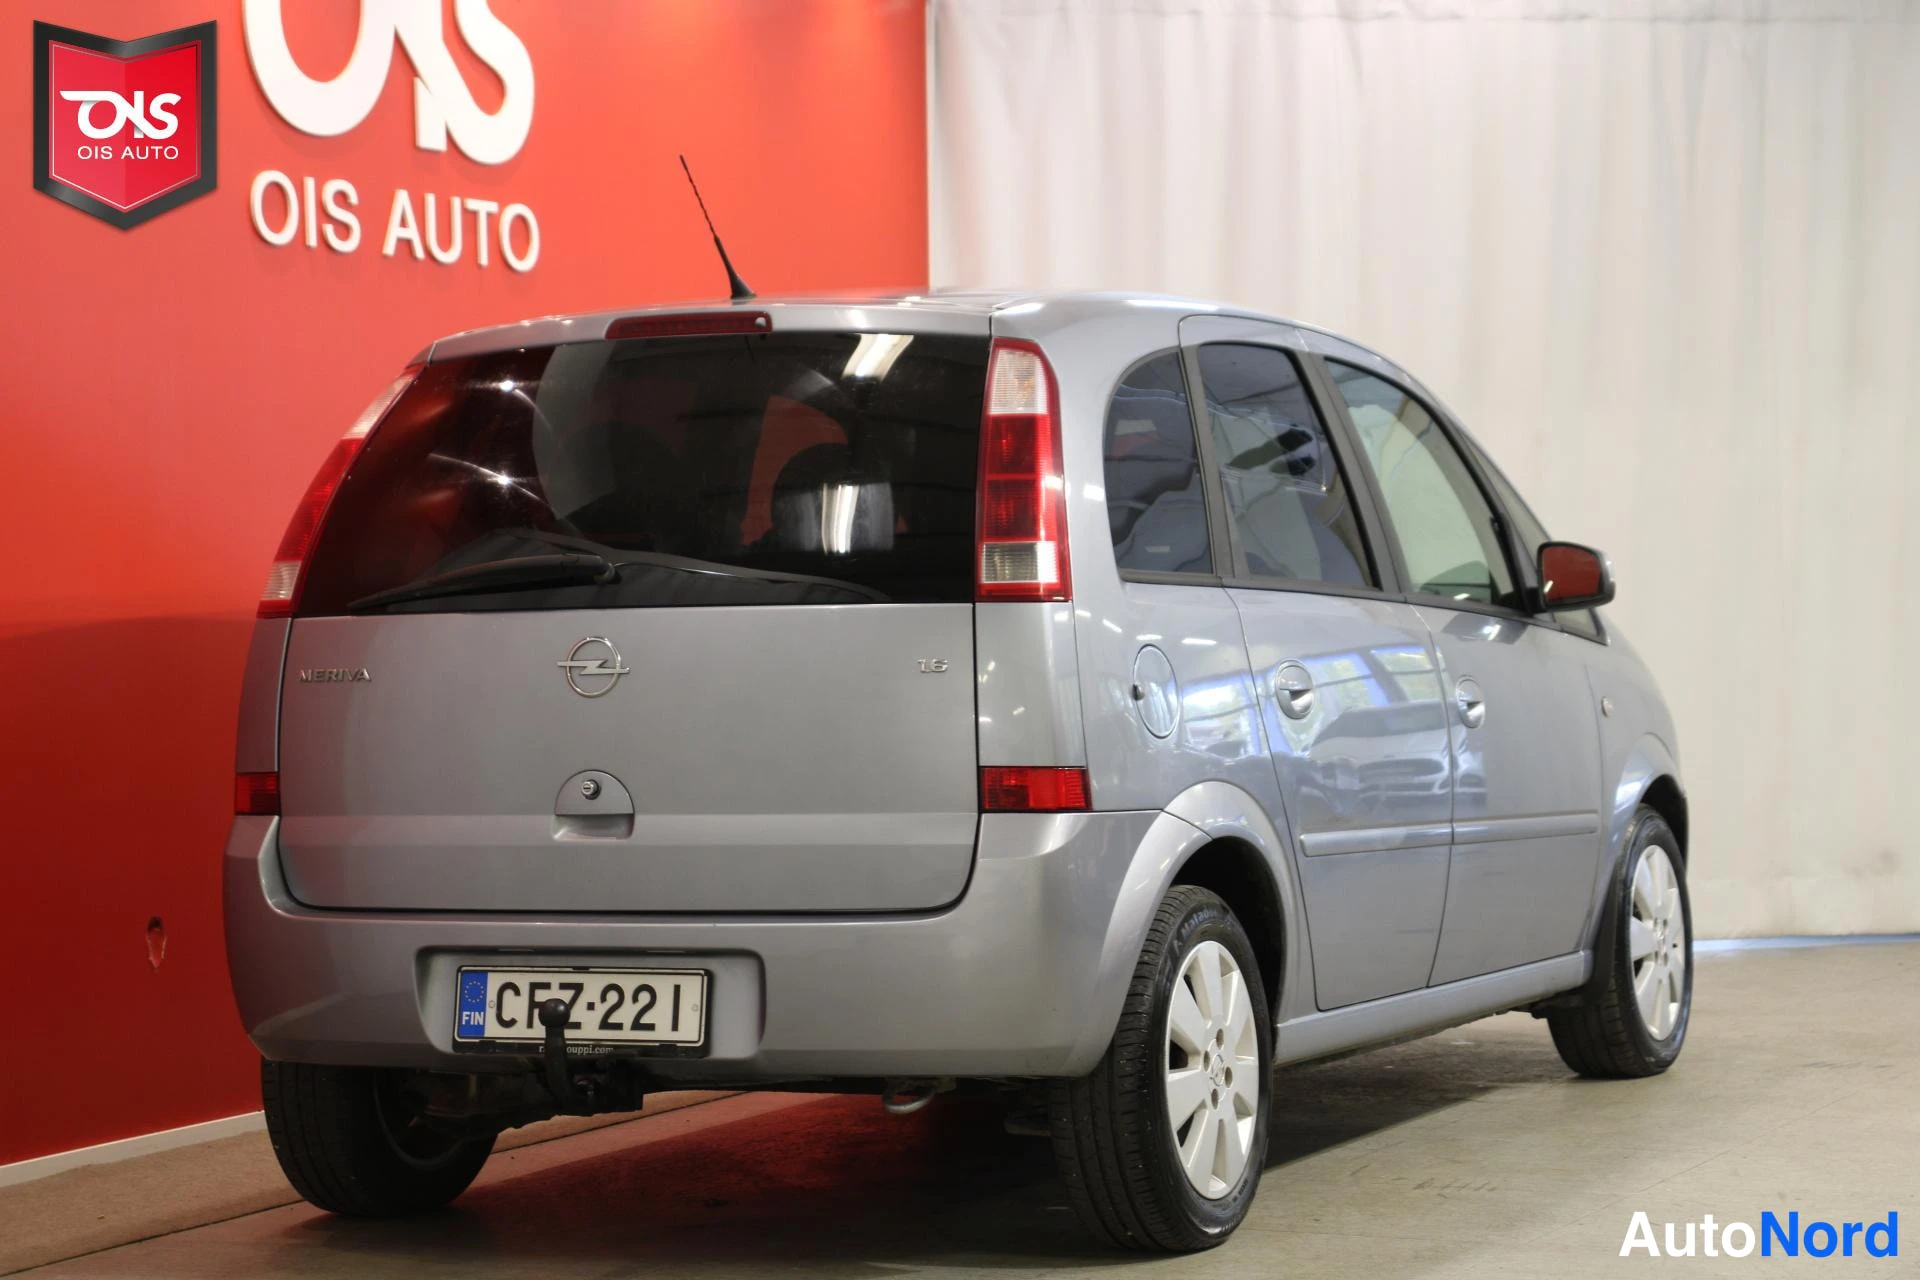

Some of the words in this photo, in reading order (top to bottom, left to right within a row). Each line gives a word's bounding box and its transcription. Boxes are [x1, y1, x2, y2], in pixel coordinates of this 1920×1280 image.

[250, 169, 361, 254] OIS
[382, 188, 540, 272] AUTO
[299, 667, 371, 682] MERIVA
[461, 1011, 485, 1026] FIN
